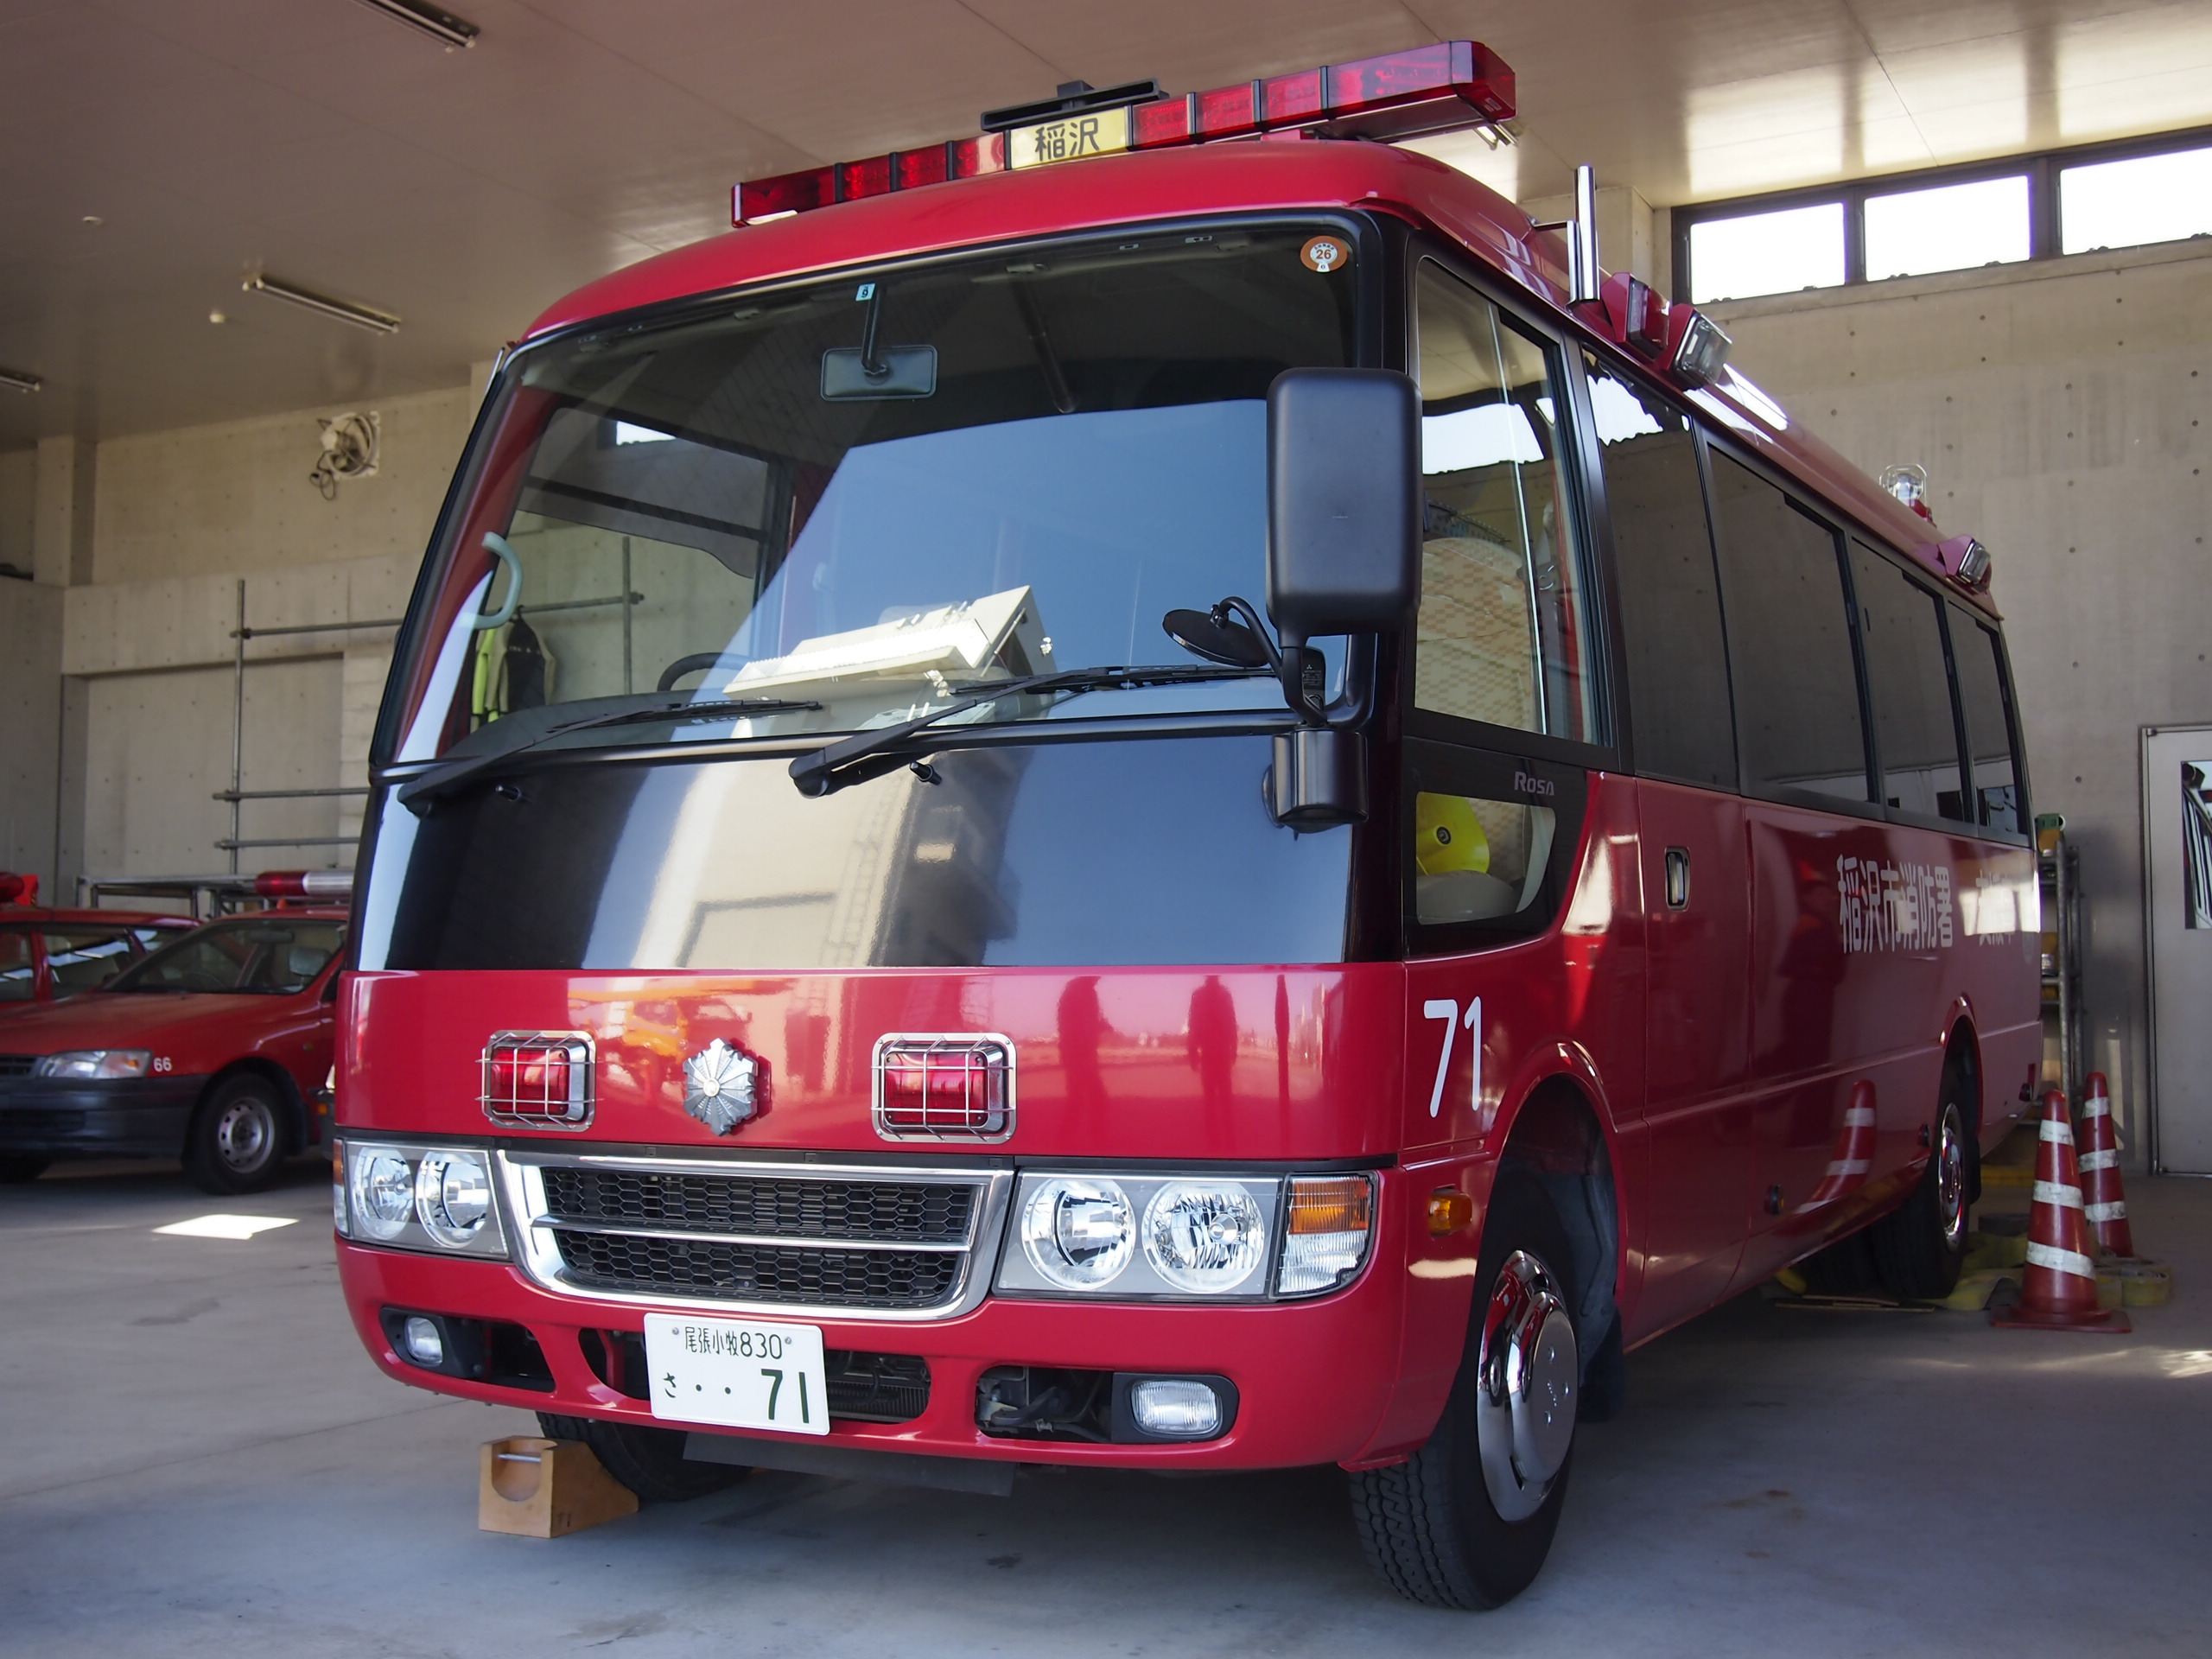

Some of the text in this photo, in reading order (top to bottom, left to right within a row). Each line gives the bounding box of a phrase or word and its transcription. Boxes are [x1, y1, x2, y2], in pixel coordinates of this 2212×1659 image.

[1034, 118, 1100, 162] 稲沢
[1316, 249, 1332, 260] 26
[1836, 854, 1953, 954] 稲沢市消防署
[153, 1057, 173, 1072] 66
[1423, 995, 1482, 1118] 71
